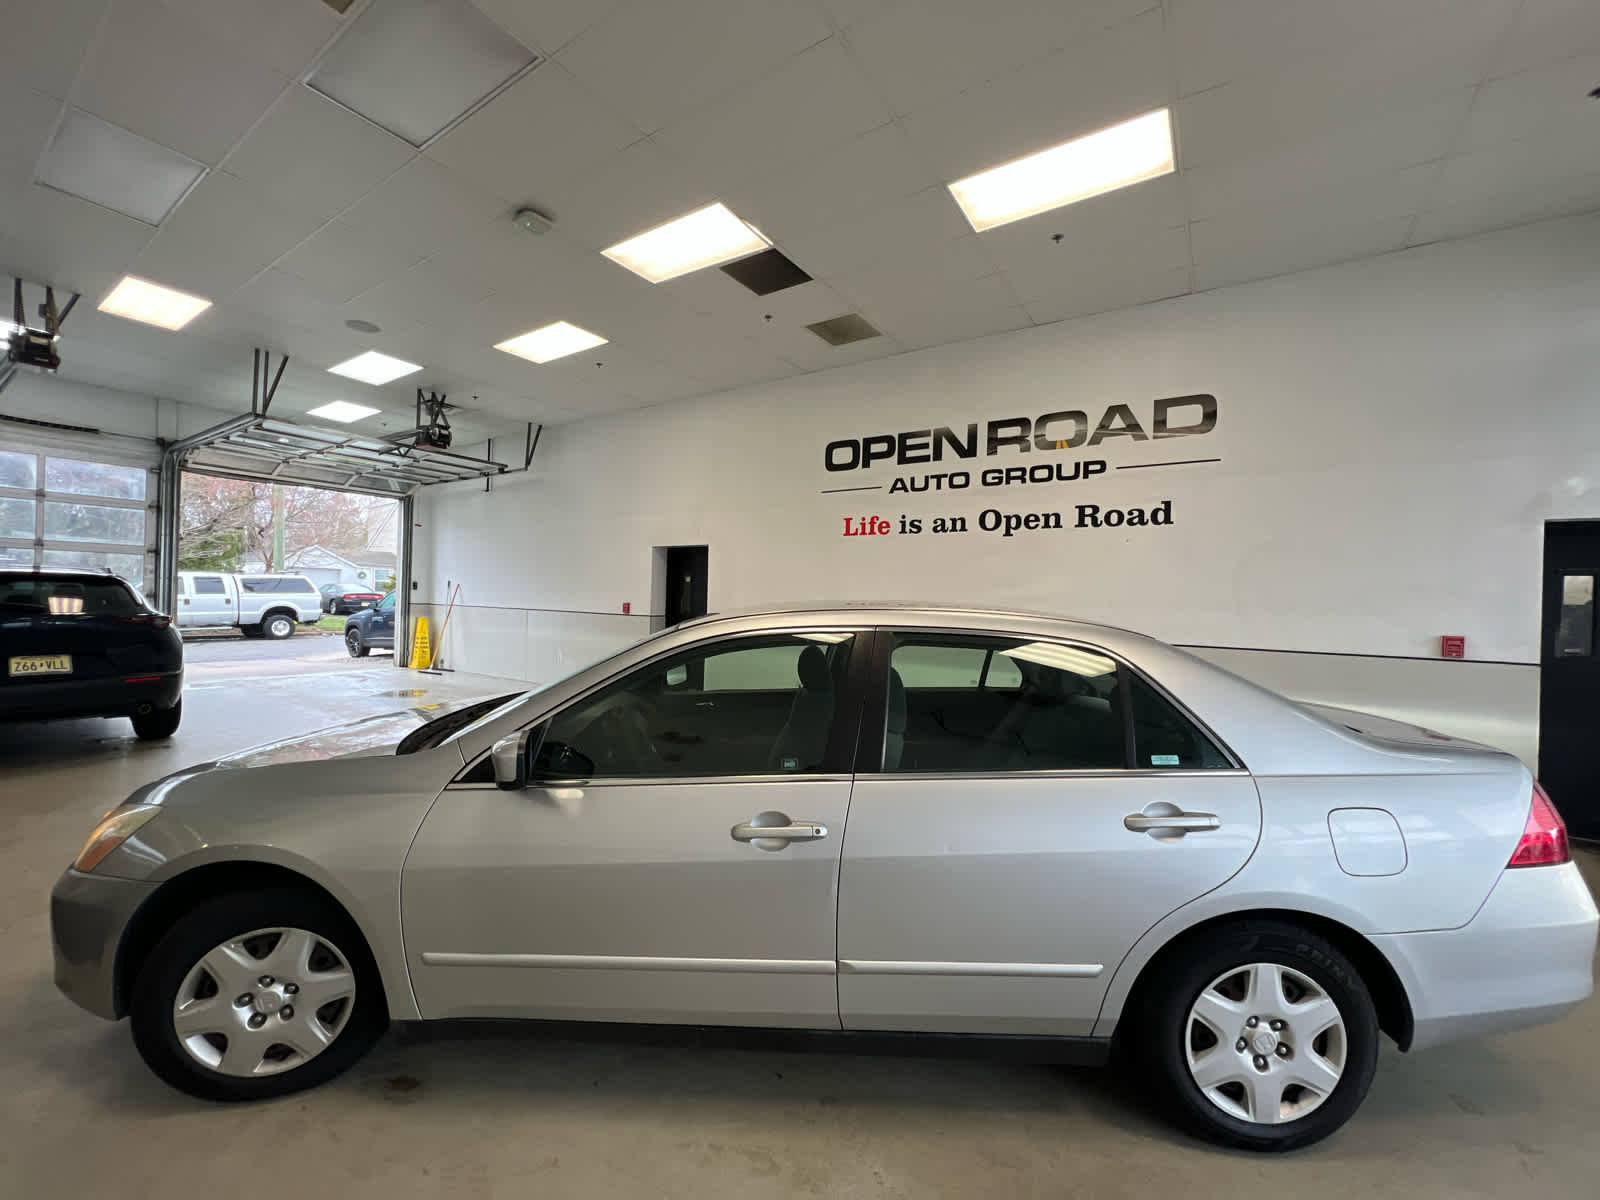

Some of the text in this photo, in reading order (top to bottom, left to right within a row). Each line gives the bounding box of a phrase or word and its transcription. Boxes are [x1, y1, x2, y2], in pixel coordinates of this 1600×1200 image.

[825, 393, 1218, 472] OPEN ROAD
[888, 460, 1108, 494] AUTO GROUP
[842, 501, 1174, 537] Life is an Open Road
